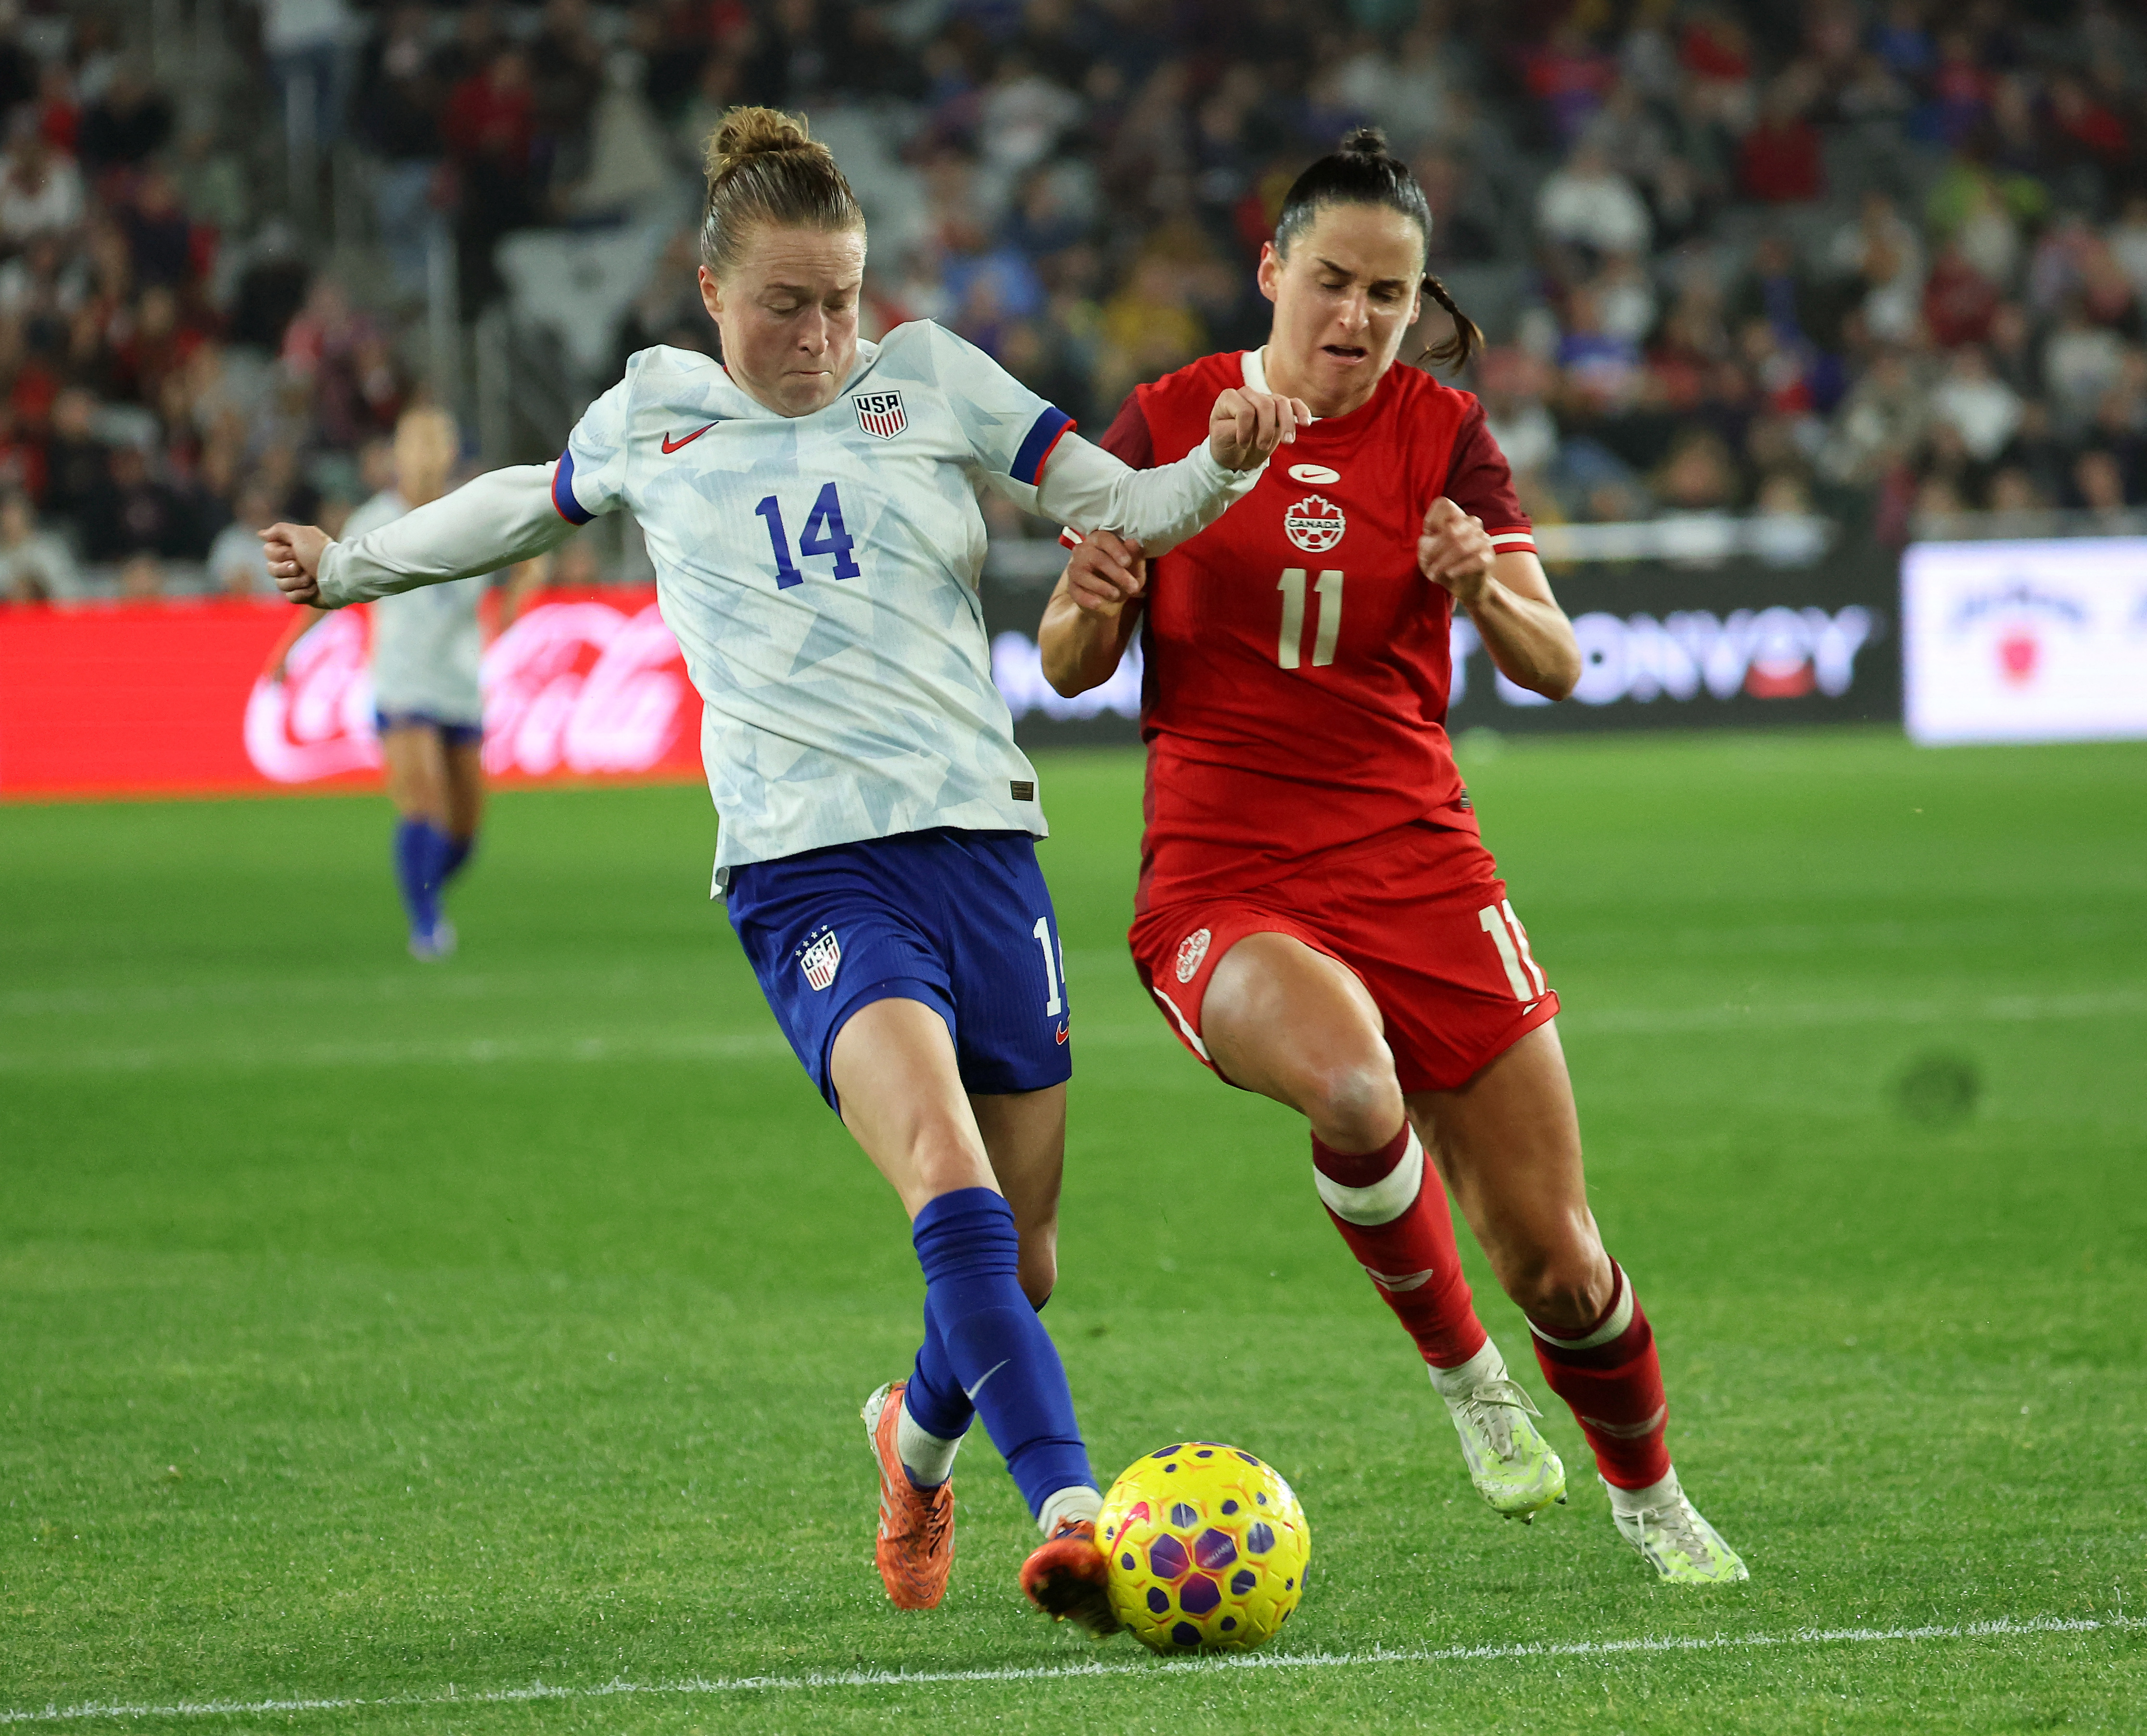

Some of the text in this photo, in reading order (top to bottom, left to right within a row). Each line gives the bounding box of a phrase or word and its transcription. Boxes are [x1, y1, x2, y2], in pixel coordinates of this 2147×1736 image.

[857, 394, 899, 414] USA
[755, 482, 861, 590] 14
[1288, 519, 1341, 529] CANADA
[1276, 568, 1345, 669] 11
[1495, 605, 1871, 706] ONVOY
[803, 935, 834, 970] USA
[1033, 916, 1065, 1017] 1
[1478, 899, 1546, 1001] 11
